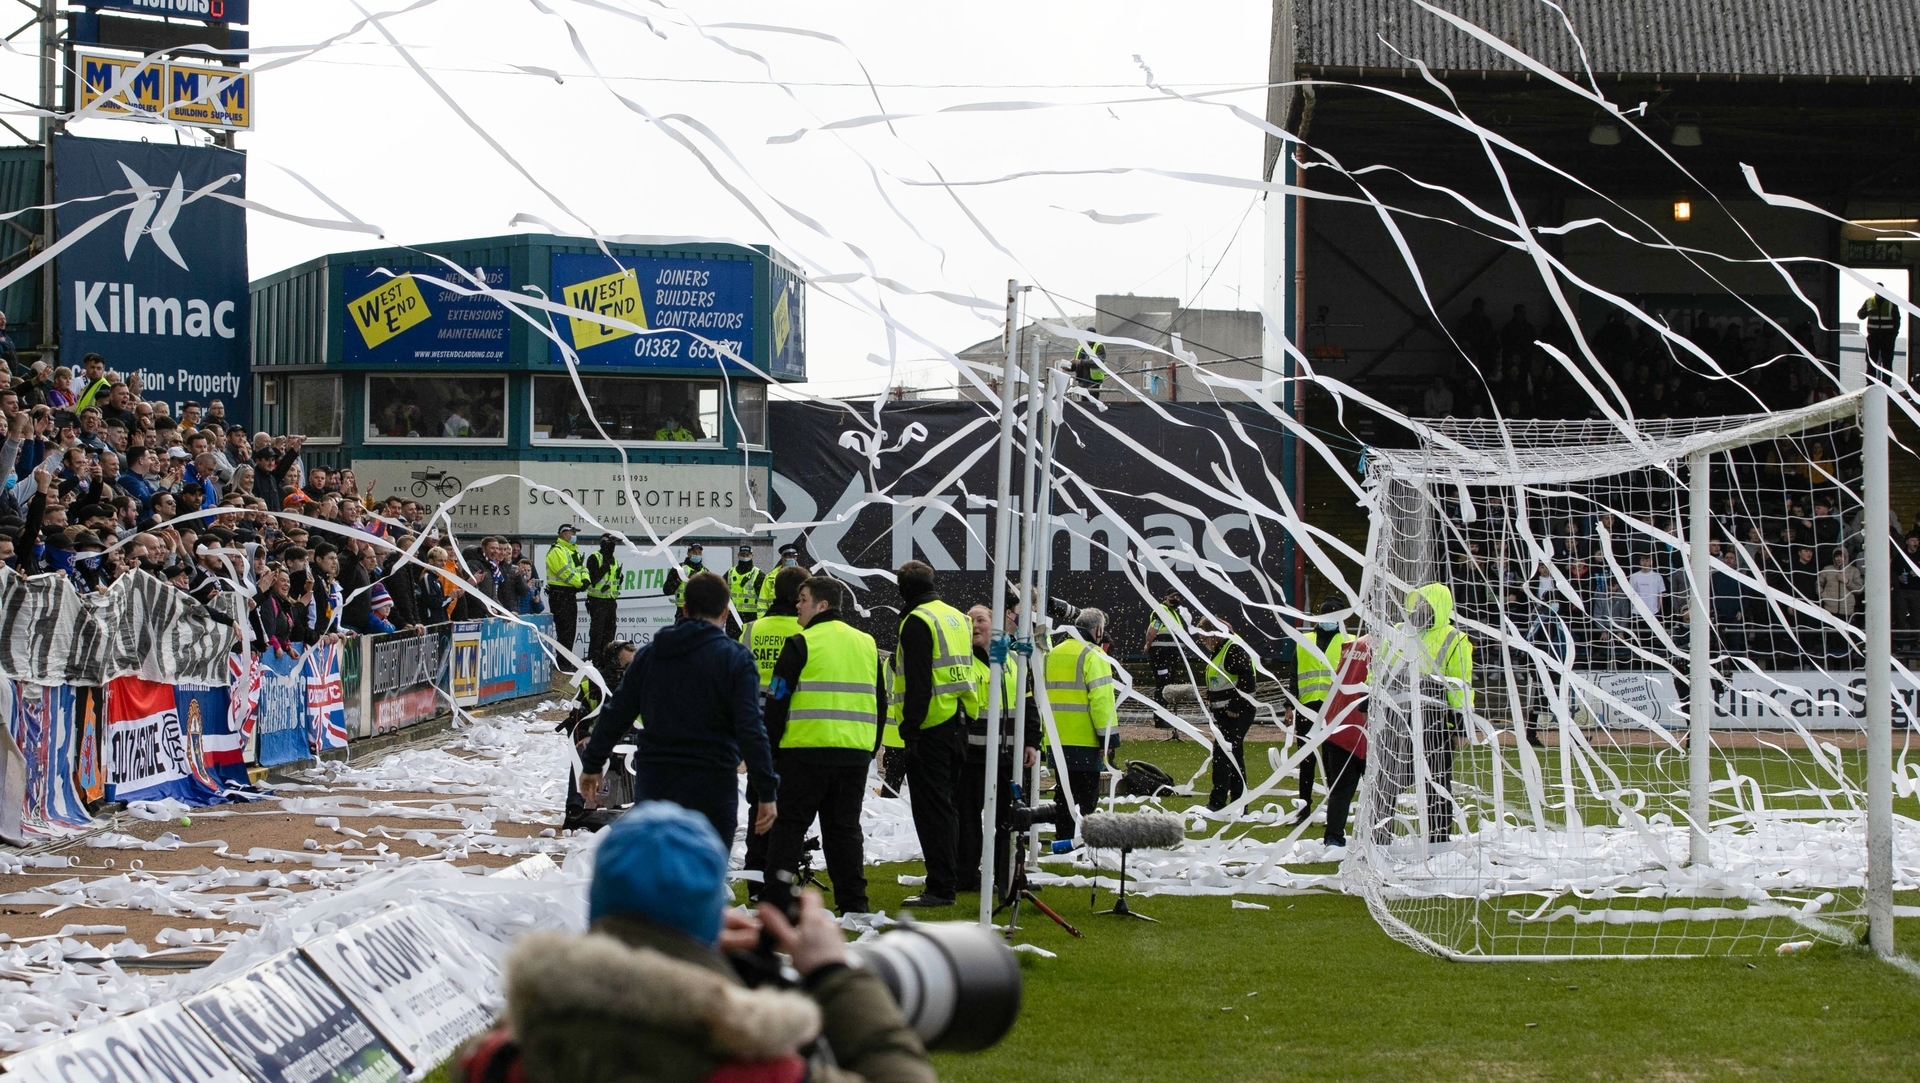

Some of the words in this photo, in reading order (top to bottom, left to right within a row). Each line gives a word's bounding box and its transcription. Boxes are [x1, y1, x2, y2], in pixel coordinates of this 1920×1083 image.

[173, 71, 245, 109] MKM
[174, 107, 209, 118] BUILDING
[210, 110, 243, 122] SUPPLIES
[445, 272, 466, 284] NEW
[655, 268, 710, 287] JOINERS
[357, 282, 403, 328] WEST
[438, 291, 464, 303] SHOP
[573, 277, 626, 323] WEST
[655, 289, 716, 308] BUILDERS
[74, 280, 236, 339] Kilmac
[383, 295, 416, 334] END
[447, 309, 504, 321] EXTENSIONS
[598, 296, 636, 336] END
[655, 310, 744, 330] CONTRACTORS
[437, 328, 504, 340] MAINTENANCE
[414, 350, 504, 359] WWW.WESTENDCLADDING.CO.UK
[633, 337, 680, 358] 01382
[177, 368, 241, 399] Property
[630, 474, 649, 482] 1935
[528, 488, 606, 507] SCOTT
[617, 489, 734, 509] BROTHERS
[425, 503, 511, 517] BOTHERS
[572, 514, 590, 524] TH
[597, 515, 637, 525] FAMILY
[646, 516, 690, 525] UTCHER
[890, 493, 1252, 573] Kilmac
[636, 616, 648, 624] (UK)
[754, 635, 788, 646] SUPERV
[480, 625, 517, 681] airdrive
[752, 648, 780, 661] SAFE
[1610, 676, 1639, 687] vehicles
[1713, 687, 1840, 718] uncan
[217, 957, 347, 1056] CROWN
